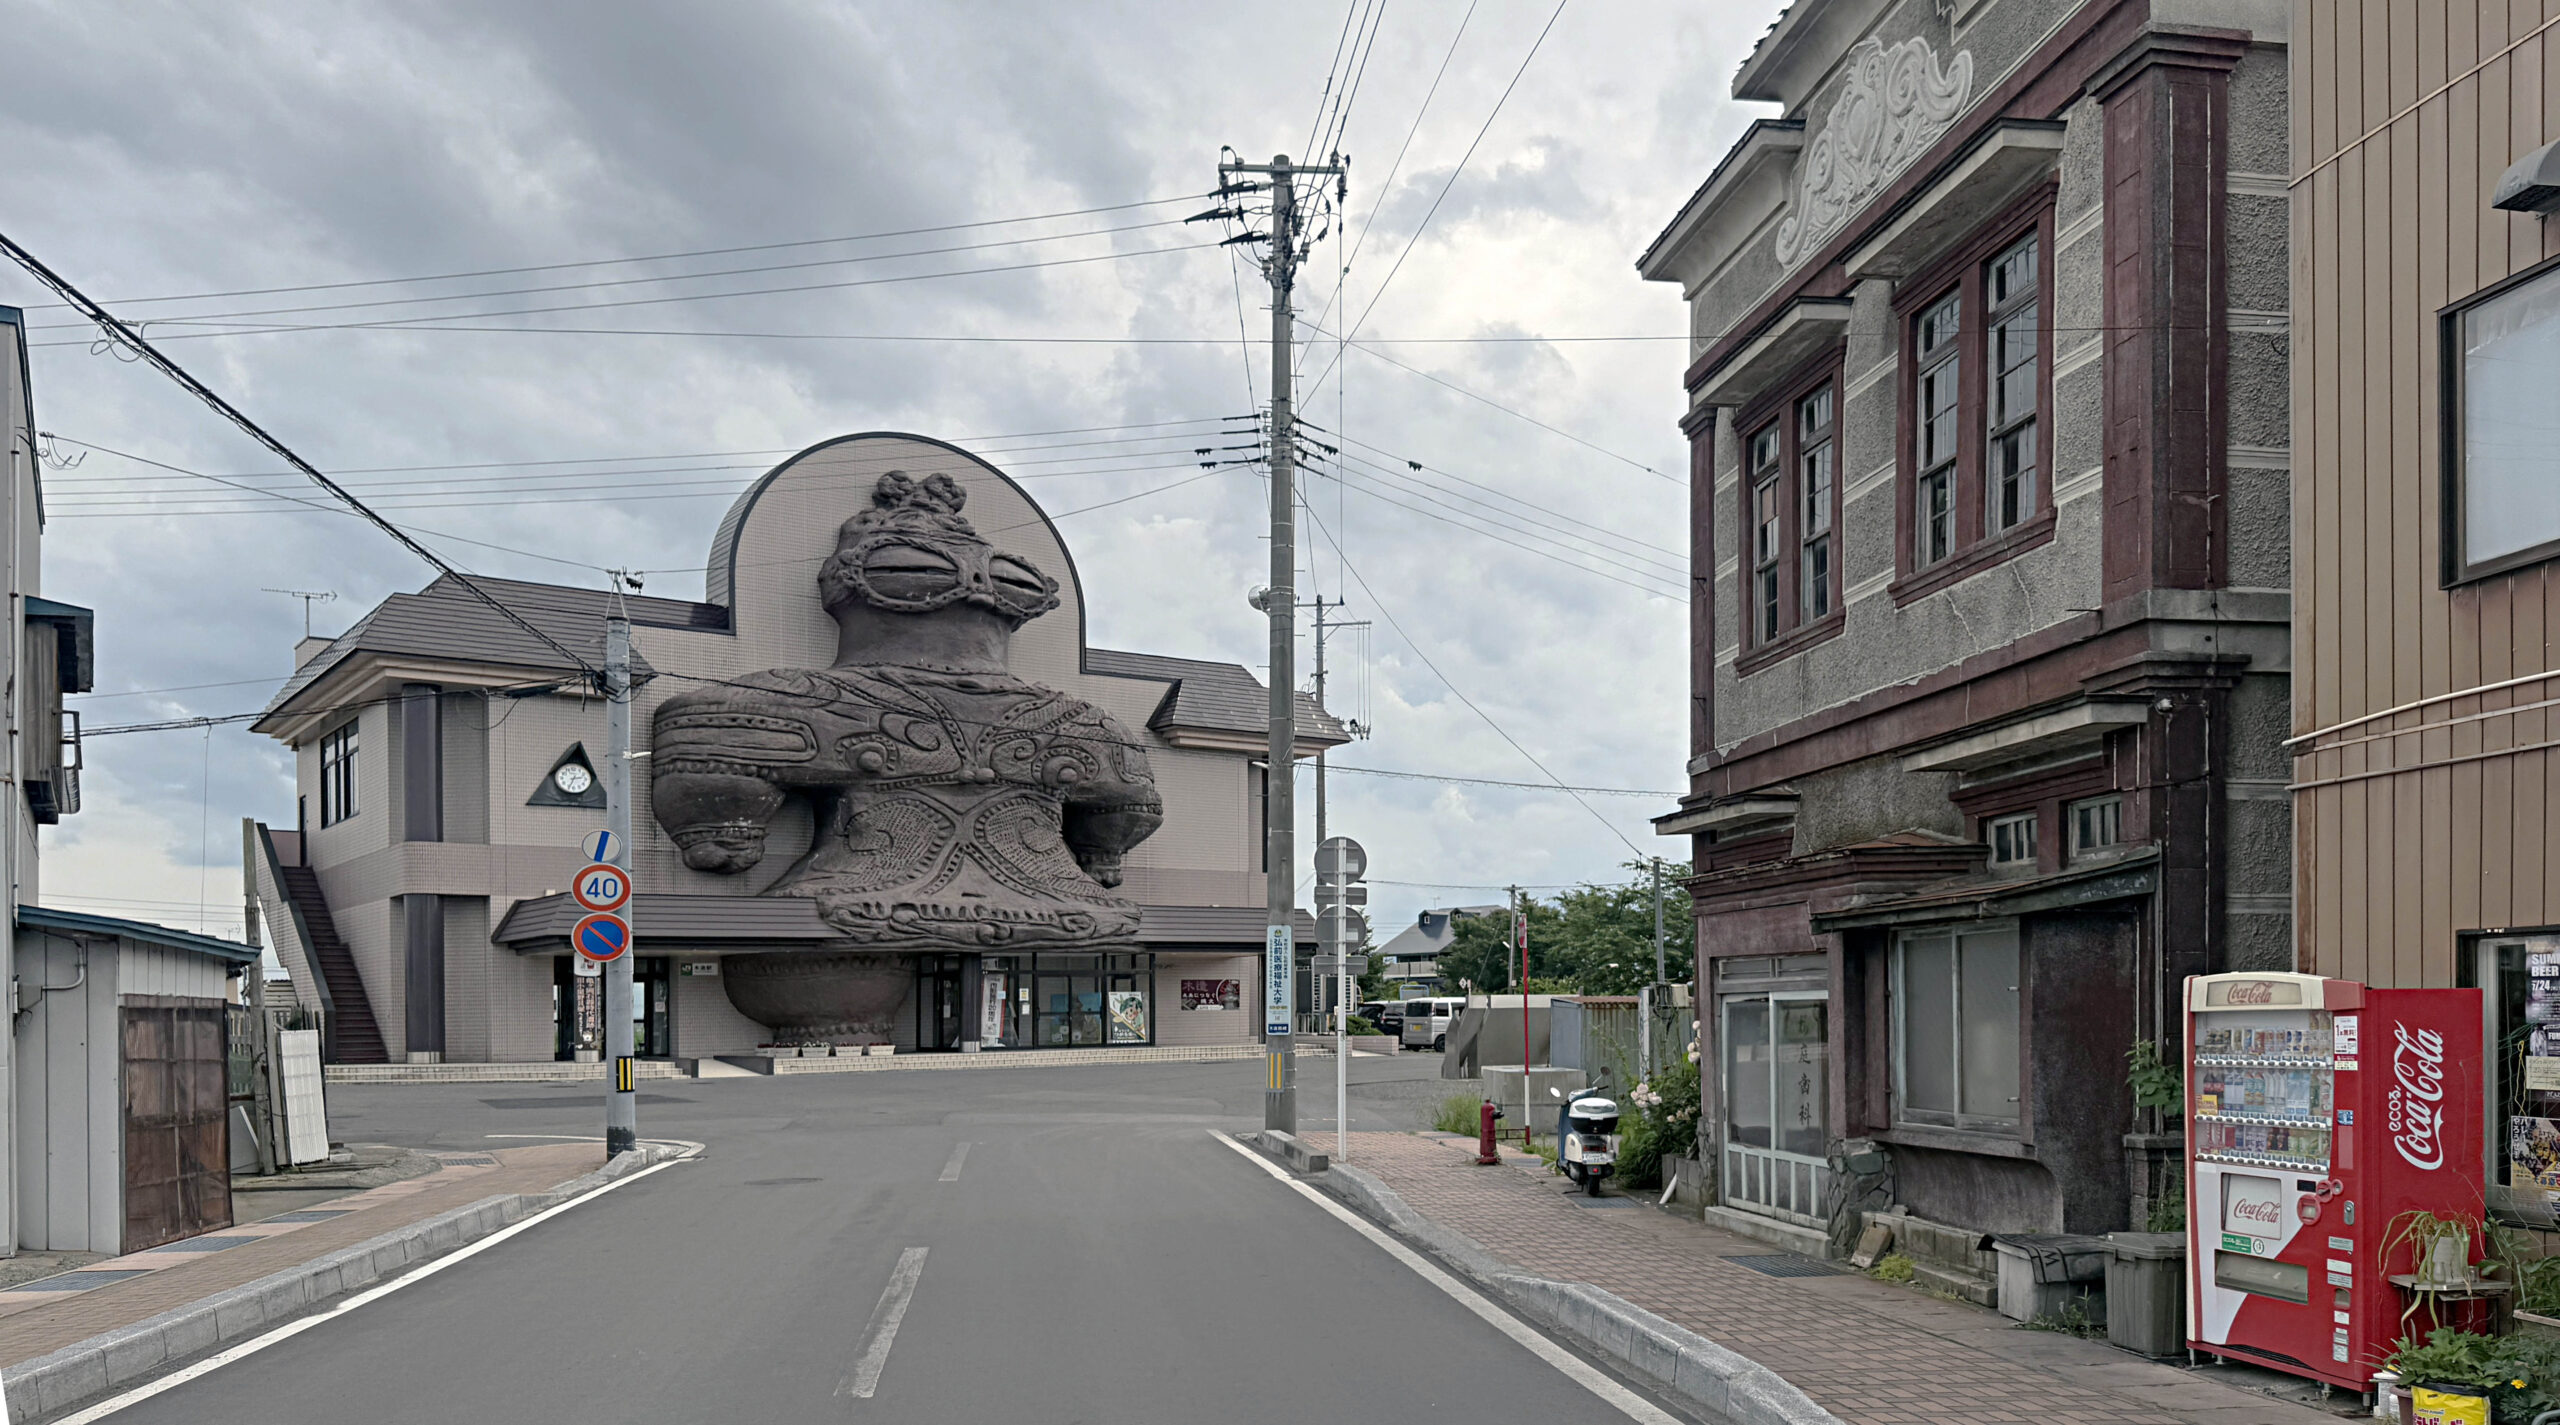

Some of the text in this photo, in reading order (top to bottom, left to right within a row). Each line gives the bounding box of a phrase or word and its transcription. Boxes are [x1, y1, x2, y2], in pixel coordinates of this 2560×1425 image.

[586, 877, 618, 899] 40
[2531, 953, 2560, 965] SUM
[1273, 938, 1282, 1005] 弘前医療福祉大学
[2531, 966, 2559, 977] BEER
[2227, 981, 2274, 1005] Coca-Cola
[2393, 1019, 2444, 1171] Coca-Cola
[2233, 1198, 2281, 1223] Coca-Cola
